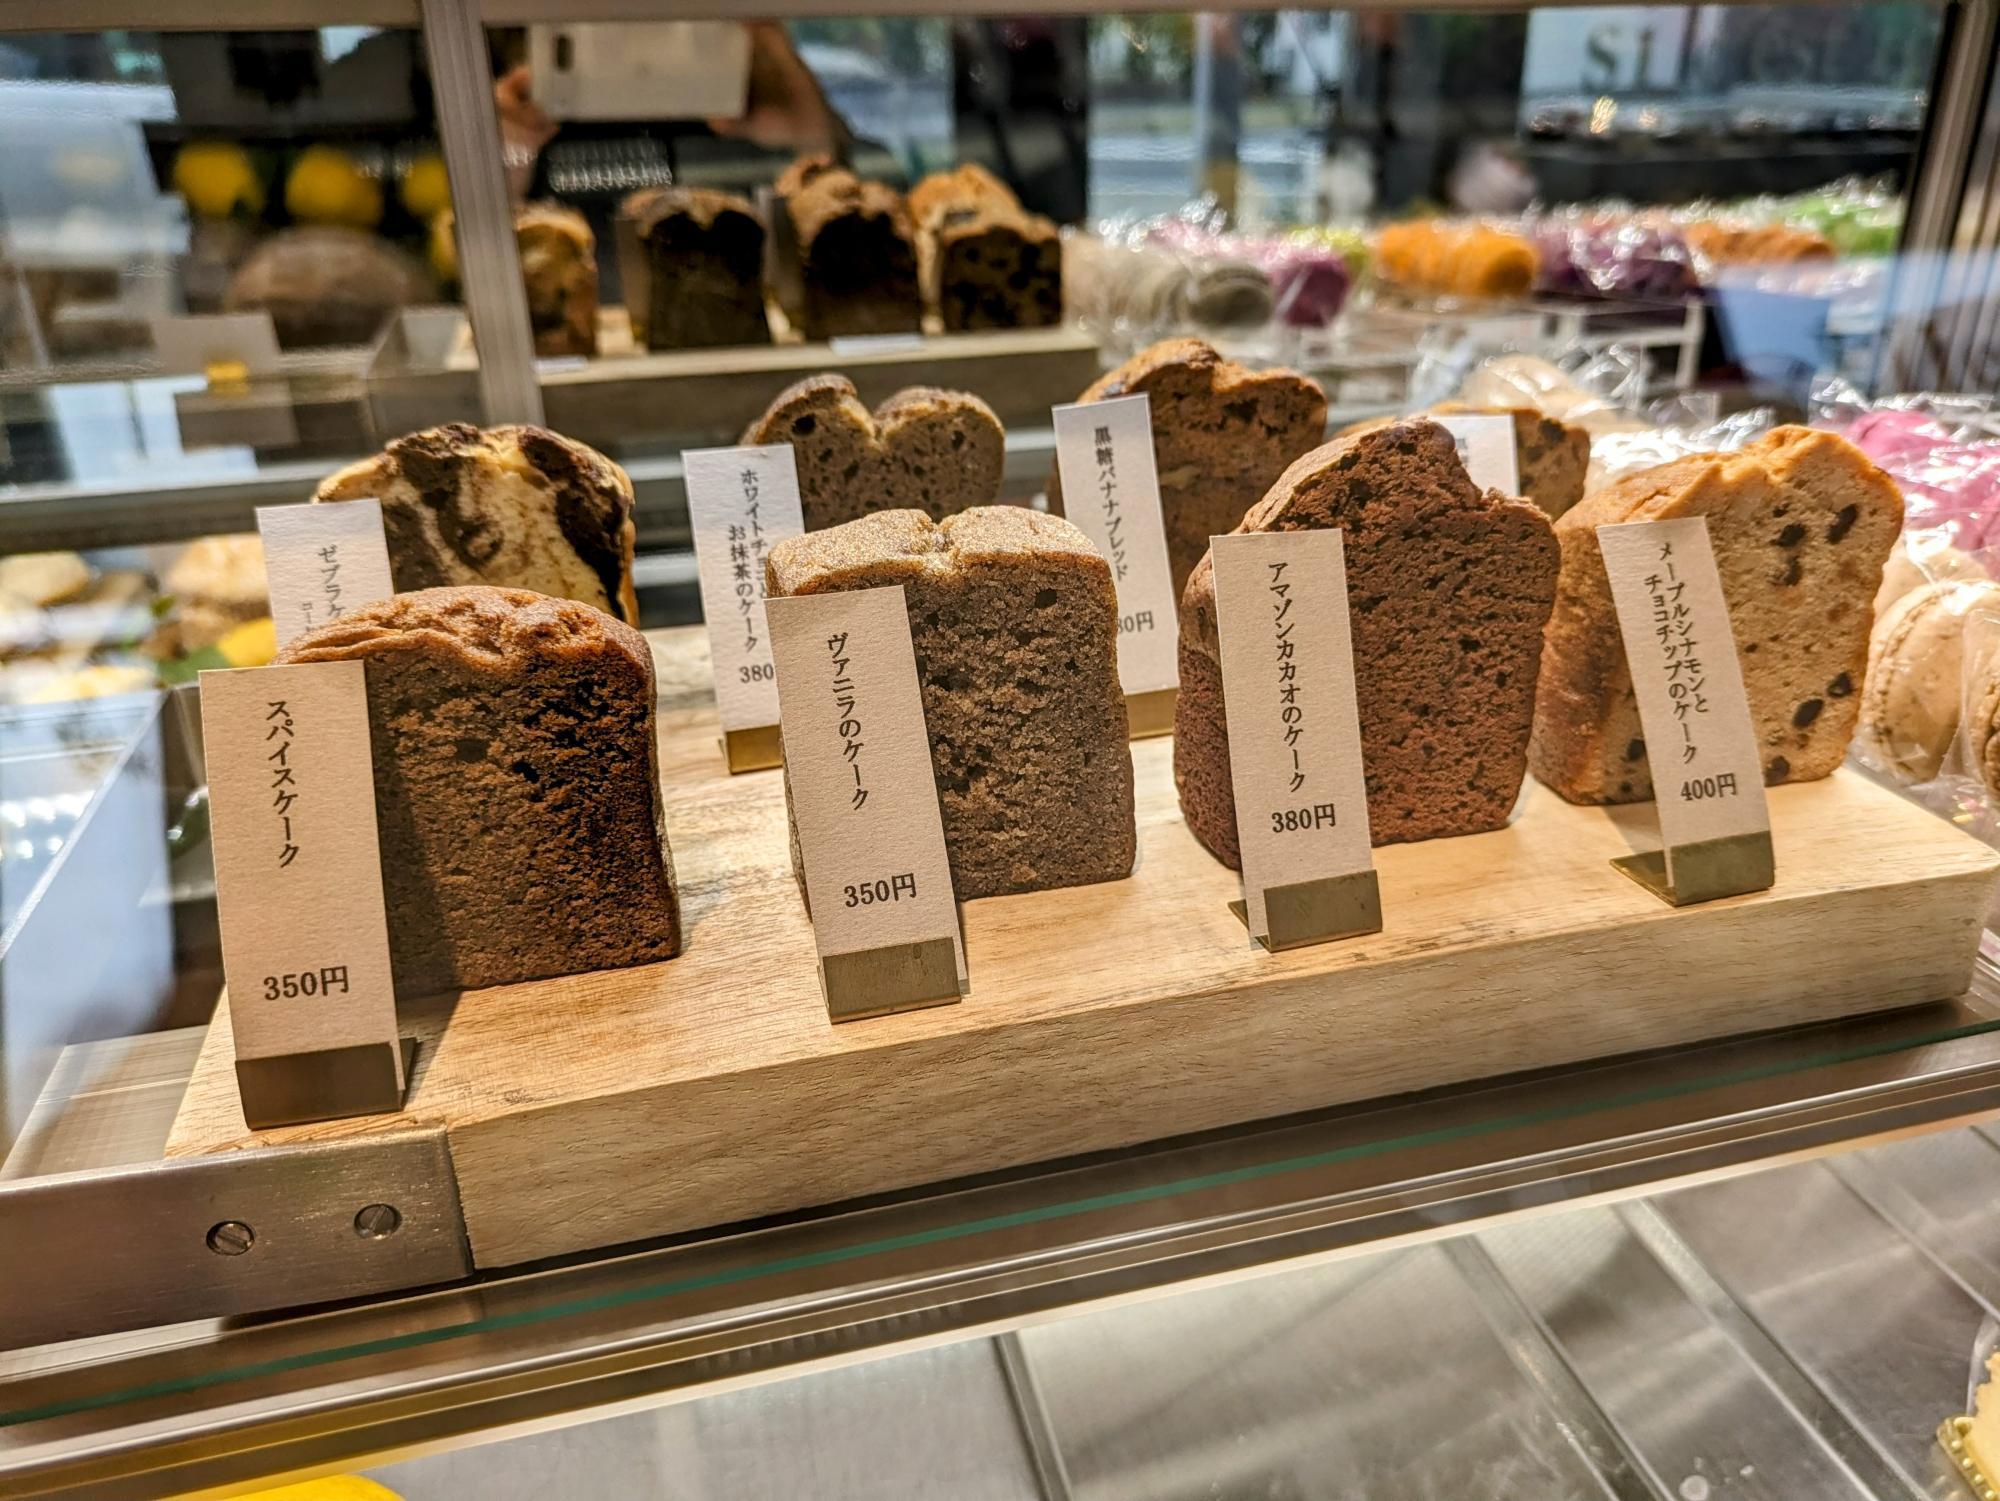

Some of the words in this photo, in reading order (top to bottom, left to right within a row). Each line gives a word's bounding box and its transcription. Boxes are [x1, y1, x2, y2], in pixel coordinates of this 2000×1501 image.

[728, 523, 758, 653] お抹茶のケーク
[1660, 542, 1708, 713] メープルシナモンと
[827, 632, 869, 812] ヴァニラのケーク
[1268, 562, 1306, 793] アマゾンカカオのケーク
[1644, 574, 1697, 765] チョコチップのケーク
[265, 700, 300, 869] スパイスケーク
[1271, 803, 1337, 833] 380円
[1680, 772, 1737, 803] 400円
[843, 872, 917, 908] 350円
[263, 965, 349, 1002] 350円
